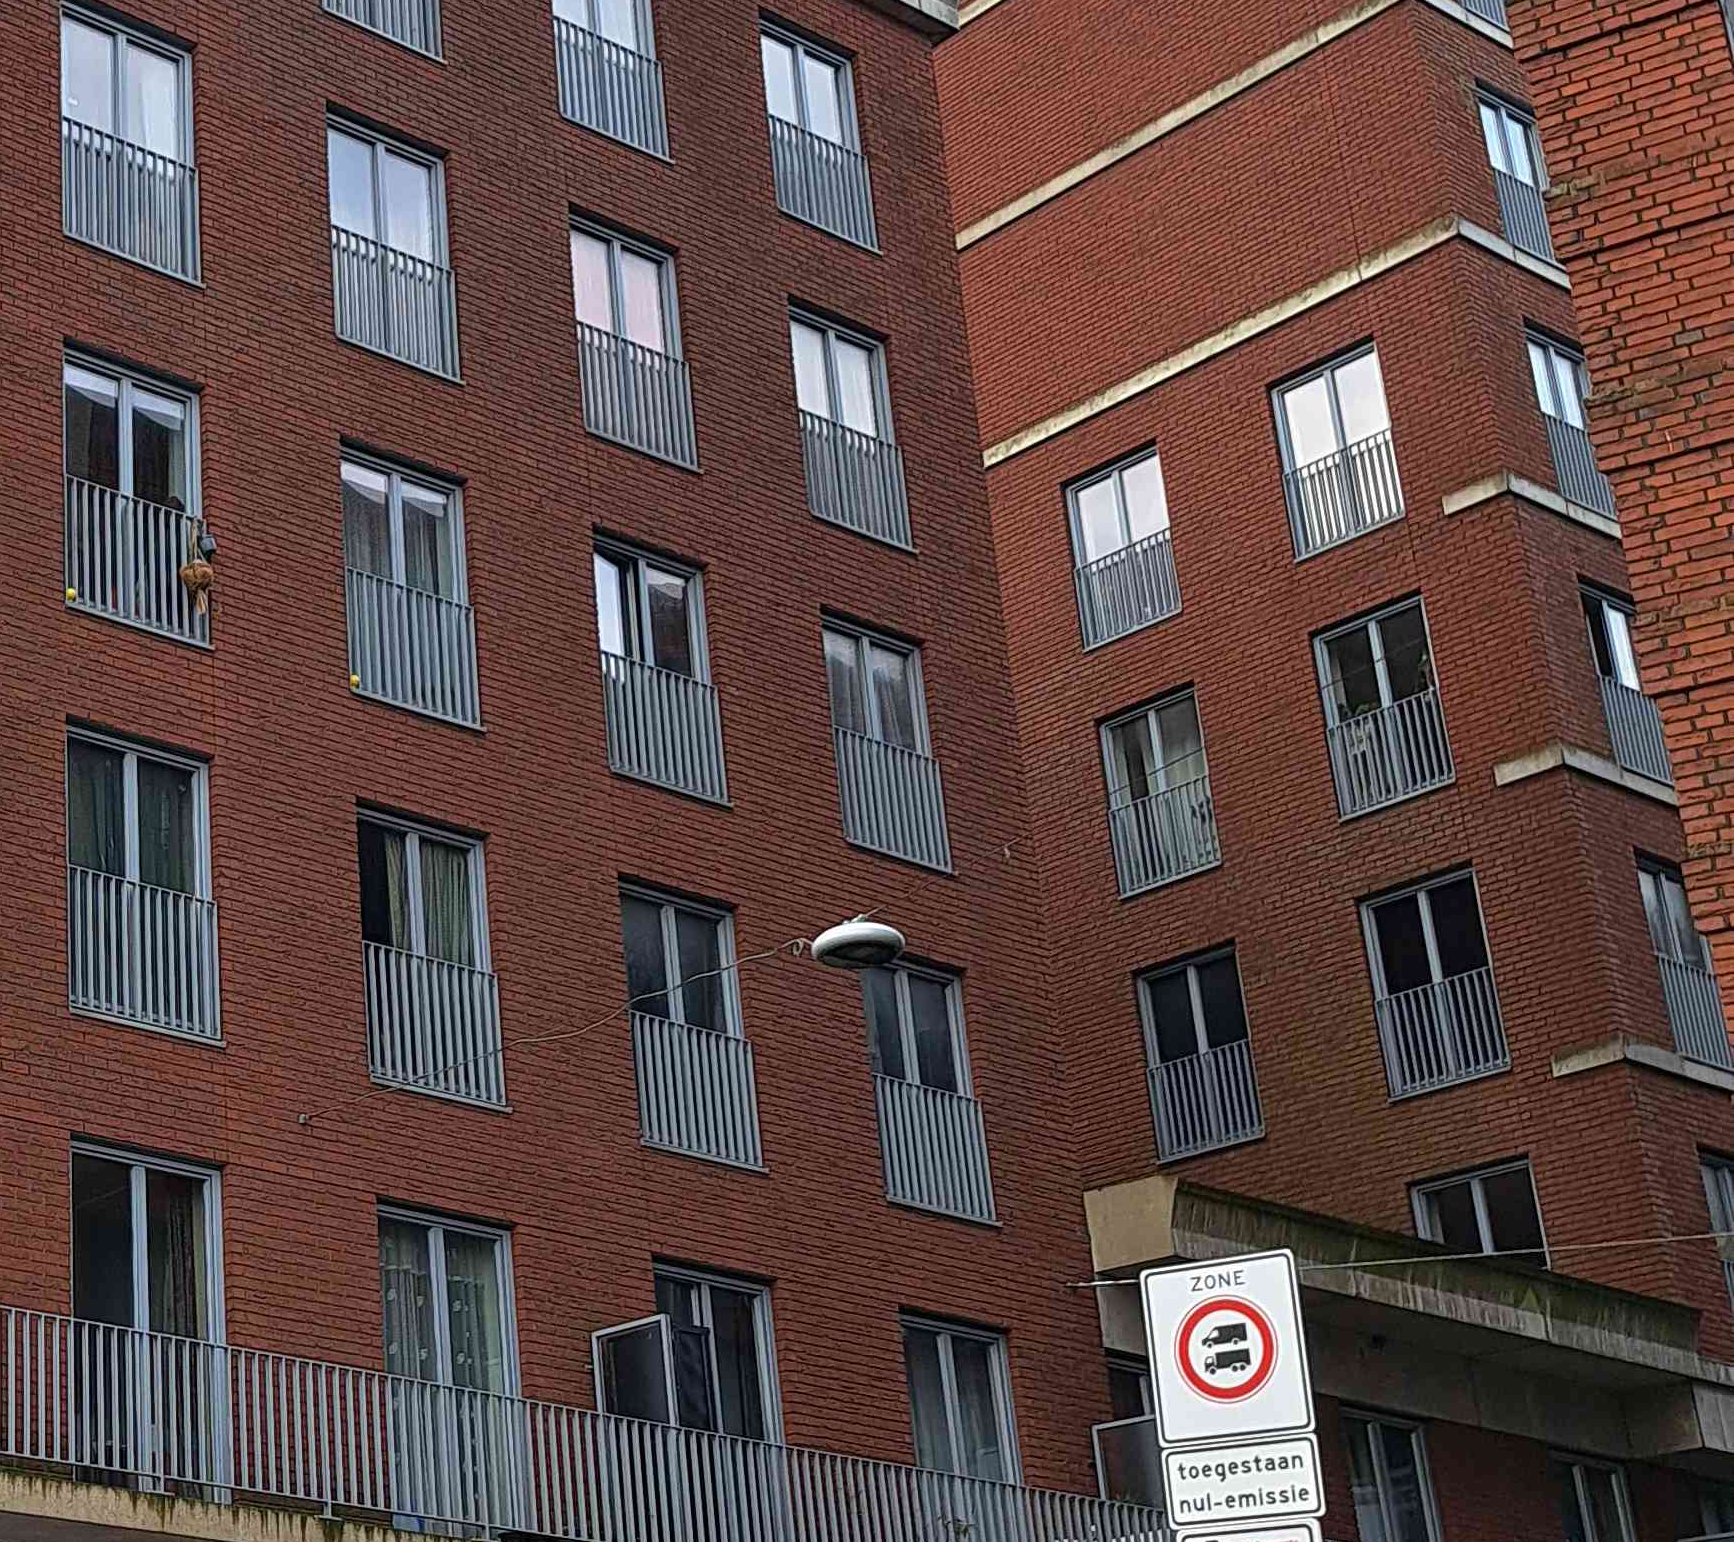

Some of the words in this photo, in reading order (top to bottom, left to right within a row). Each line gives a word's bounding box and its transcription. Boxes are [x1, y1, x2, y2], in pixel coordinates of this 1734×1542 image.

[1190, 1270, 1245, 1292] ZONE
[1178, 1455, 1304, 1482] toegestaan
[1180, 1484, 1309, 1513] nul-emissie
